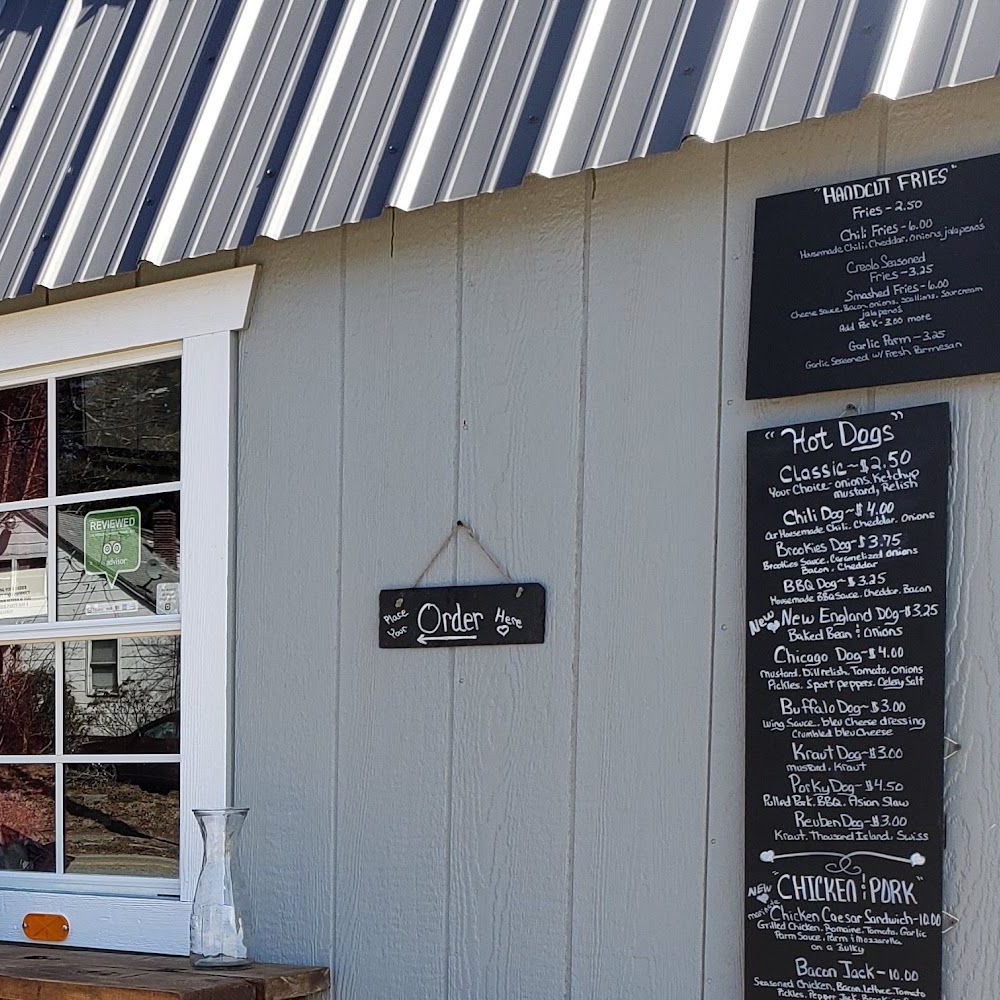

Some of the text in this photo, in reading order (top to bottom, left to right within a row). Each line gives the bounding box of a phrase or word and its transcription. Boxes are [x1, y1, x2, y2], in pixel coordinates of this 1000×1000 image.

[852, 206, 883, 219] Fries
[840, 223, 899, 242] Chili Fries
[881, 252, 925, 270] Seasoned
[870, 271, 899, 283] Fries
[844, 282, 919, 302] Smashed Fries
[839, 313, 932, 332] Add more
[849, 334, 911, 351] Garlic Parm
[805, 360, 830, 369] Garlic
[831, 353, 869, 366] Seasoned
[885, 349, 911, 358] Fresh
[913, 342, 962, 354] Parmesan
[768, 468, 919, 499] Your Ketchup
[883, 478, 918, 492] Relish
[90, 517, 135, 530] REVIEWED
[783, 507, 817, 526] Chili
[838, 561, 878, 571] Cheddar
[783, 579, 815, 593] BBQ
[903, 584, 932, 594] Bacon
[383, 609, 409, 624] Place
[418, 603, 522, 633] Order Here
[749, 610, 774, 636] New
[781, 606, 872, 626] New England
[387, 626, 408, 639] Your
[787, 628, 823, 642] Baked
[826, 627, 852, 640] Bean
[774, 646, 828, 666] Chicago
[807, 680, 834, 692] Sport
[905, 676, 924, 686] Salt
[780, 698, 835, 715] Buffalo
[880, 716, 926, 729] dressing
[792, 742, 834, 761] Kraut
[834, 762, 867, 771] Kraut
[788, 774, 829, 795] Porky
[849, 795, 880, 807] Asian
[882, 797, 909, 806] Slaw
[794, 811, 842, 828] Reuben
[896, 830, 929, 841] Swiss
[748, 884, 772, 897] NEW
[770, 905, 820, 922] Chicken
[822, 907, 862, 924] Caesar
[757, 921, 927, 937] Grilled Garlic
[795, 957, 837, 977] Bacon
[838, 961, 875, 979] Jack
[753, 978, 794, 988] Seasoned
